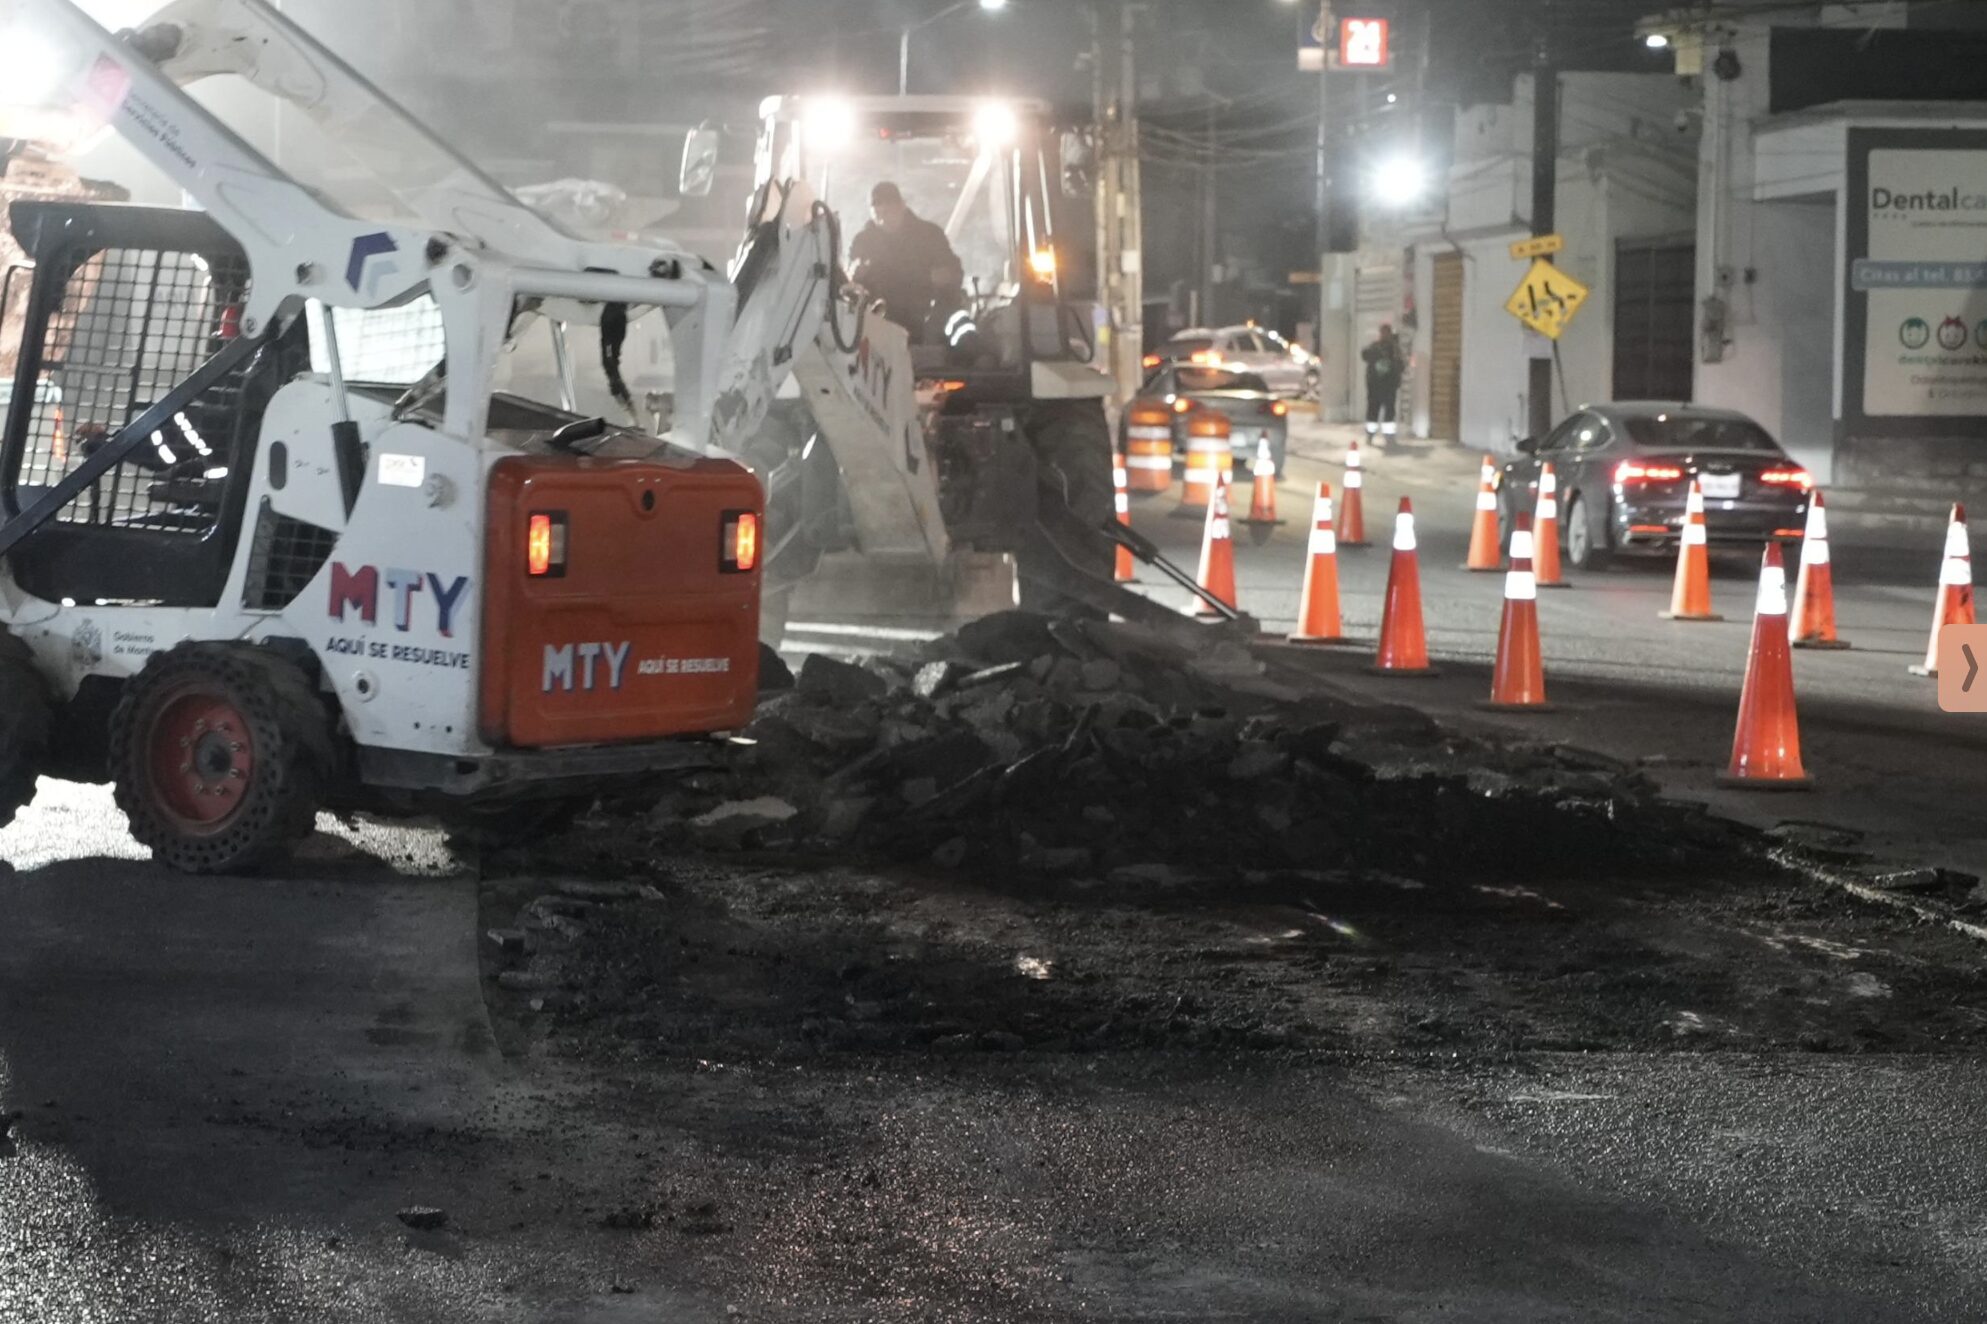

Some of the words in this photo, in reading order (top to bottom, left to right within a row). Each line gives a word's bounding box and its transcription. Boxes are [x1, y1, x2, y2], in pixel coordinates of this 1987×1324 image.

[328, 561, 472, 638] MTY
[325, 635, 367, 656] AQUÍ
[368, 641, 389, 660] SE
[391, 645, 471, 670] RESUELVE
[541, 641, 631, 692] MTY
[637, 655, 665, 675] AQUÍ
[666, 658, 680, 673] SE
[680, 657, 730, 674] RESUELVE
